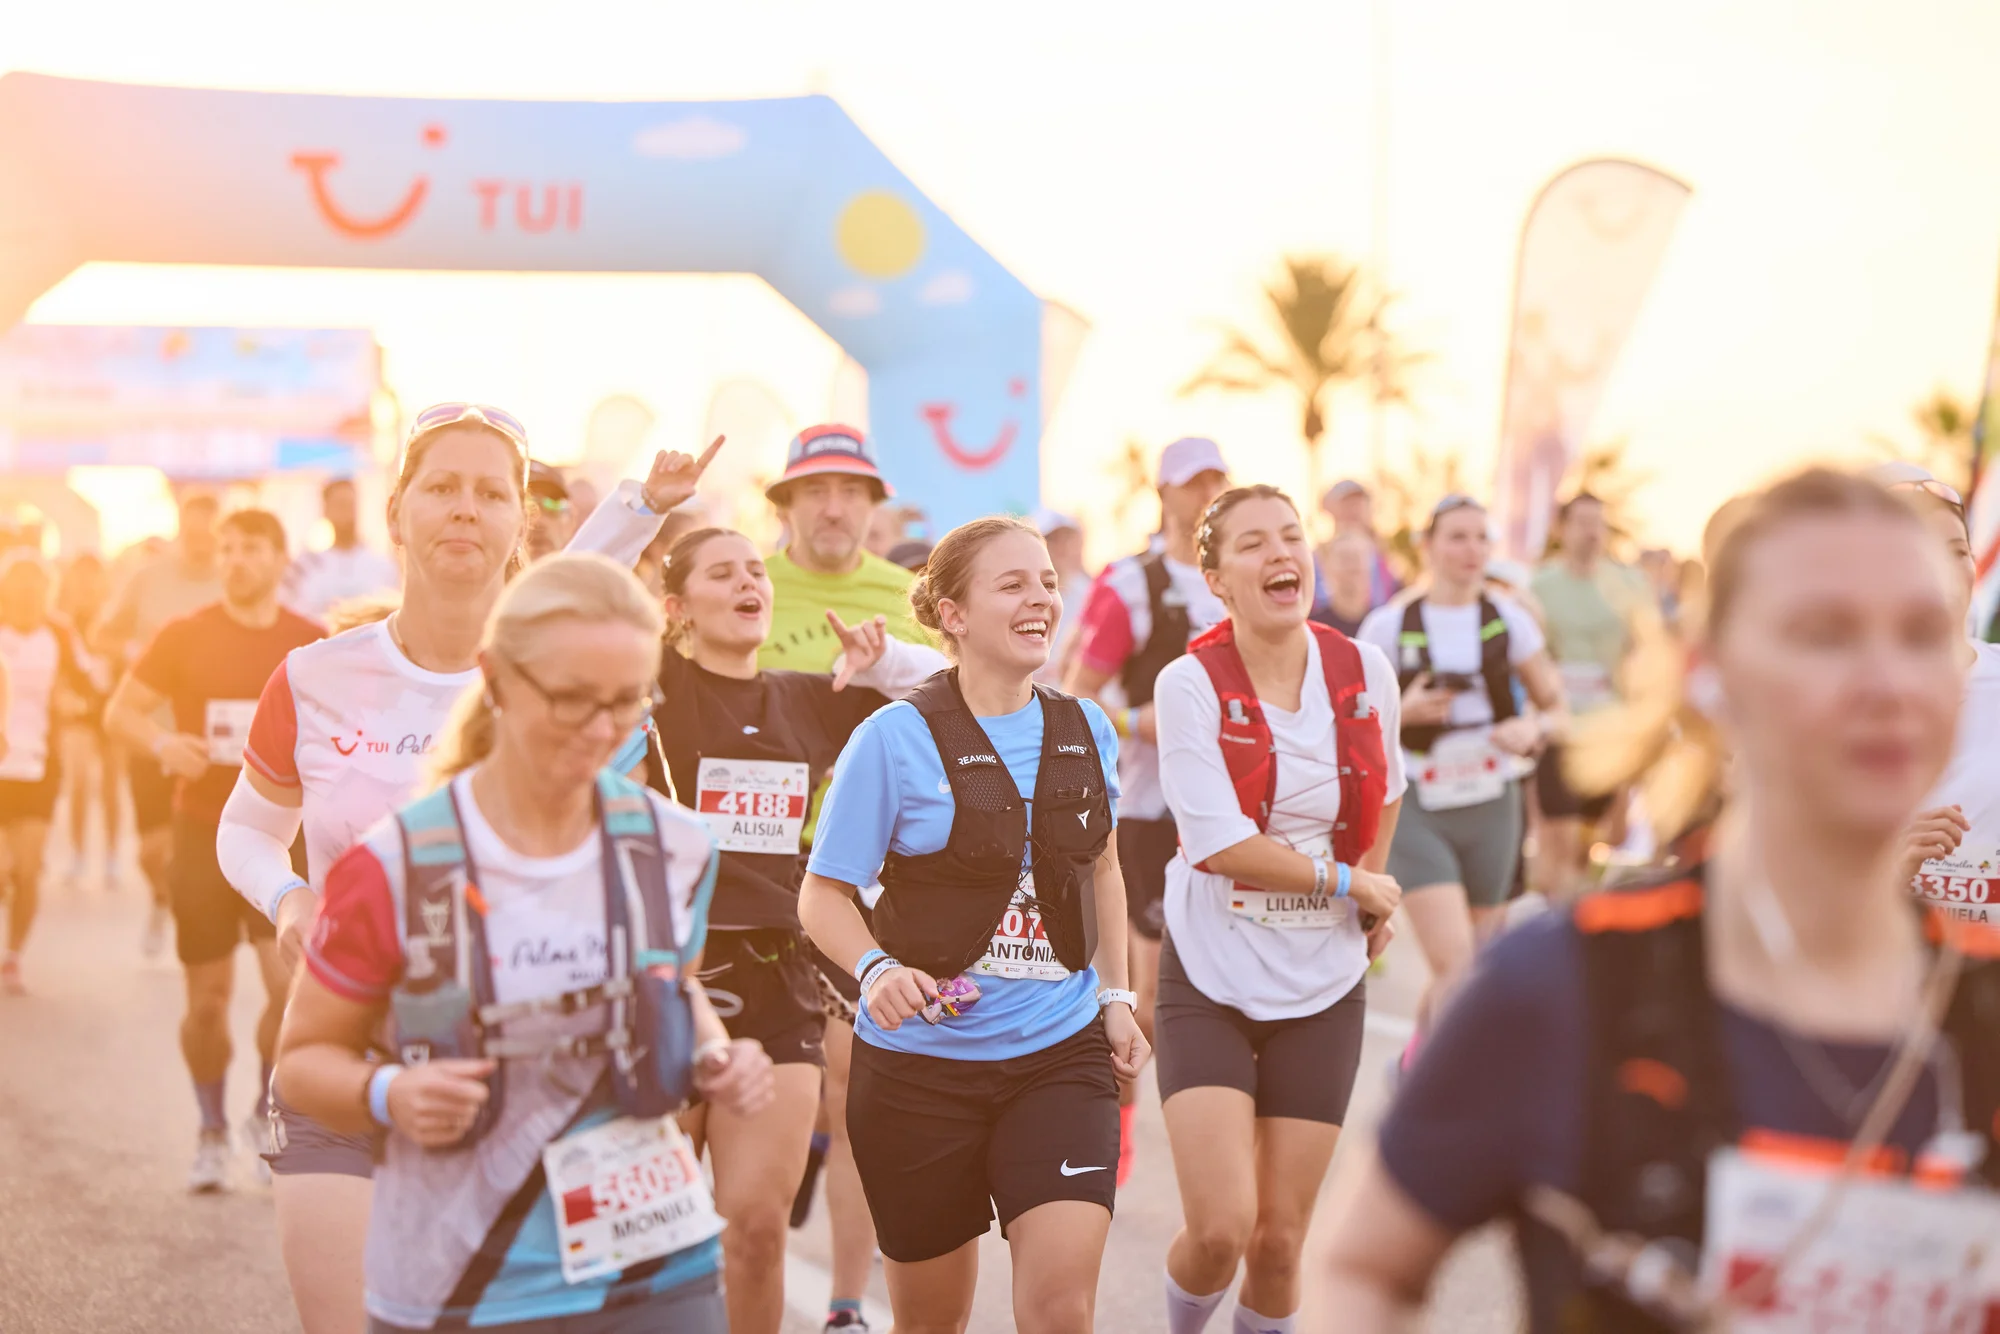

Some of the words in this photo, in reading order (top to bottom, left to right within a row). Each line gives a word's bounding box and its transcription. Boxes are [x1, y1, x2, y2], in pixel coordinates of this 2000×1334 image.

[472, 181, 582, 233] TUI
[367, 742, 389, 753] TUI
[396, 733, 432, 755] Pal
[957, 754, 997, 766] REAKING
[718, 791, 790, 817] 4188
[732, 821, 784, 837] ALISIJA
[1266, 898, 1329, 911] LILIANA
[995, 909, 1048, 939] 07
[985, 941, 1056, 962] ANTONIA
[594, 1152, 689, 1216] 5609
